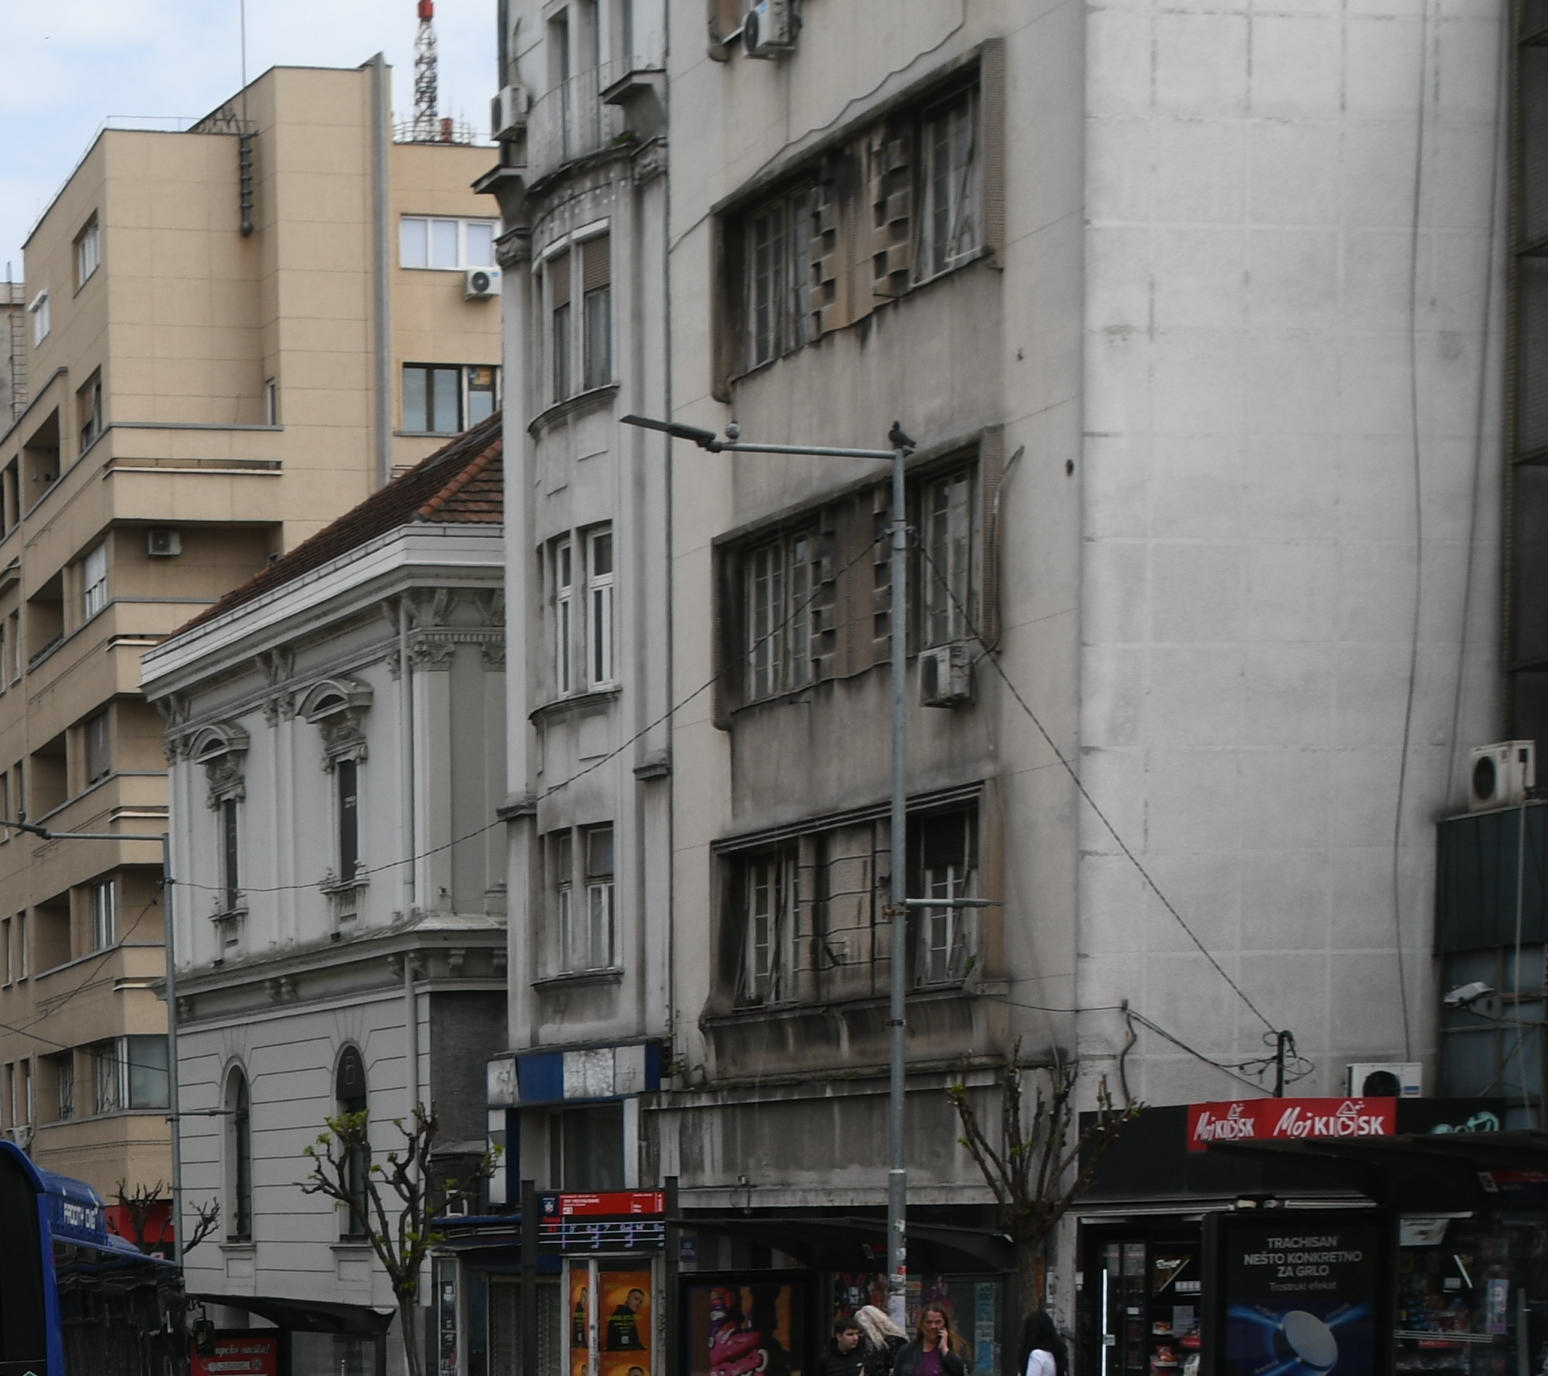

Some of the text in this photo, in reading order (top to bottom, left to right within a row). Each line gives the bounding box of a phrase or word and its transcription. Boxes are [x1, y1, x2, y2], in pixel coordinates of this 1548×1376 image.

[1273, 1106, 1385, 1139] Moj KIOSK
[1267, 1236, 1337, 1248] TRACHISAN
[1244, 1250, 1363, 1266] NEŠTO KONKRETNO
[1277, 1265, 1330, 1278] ZA GRLO
